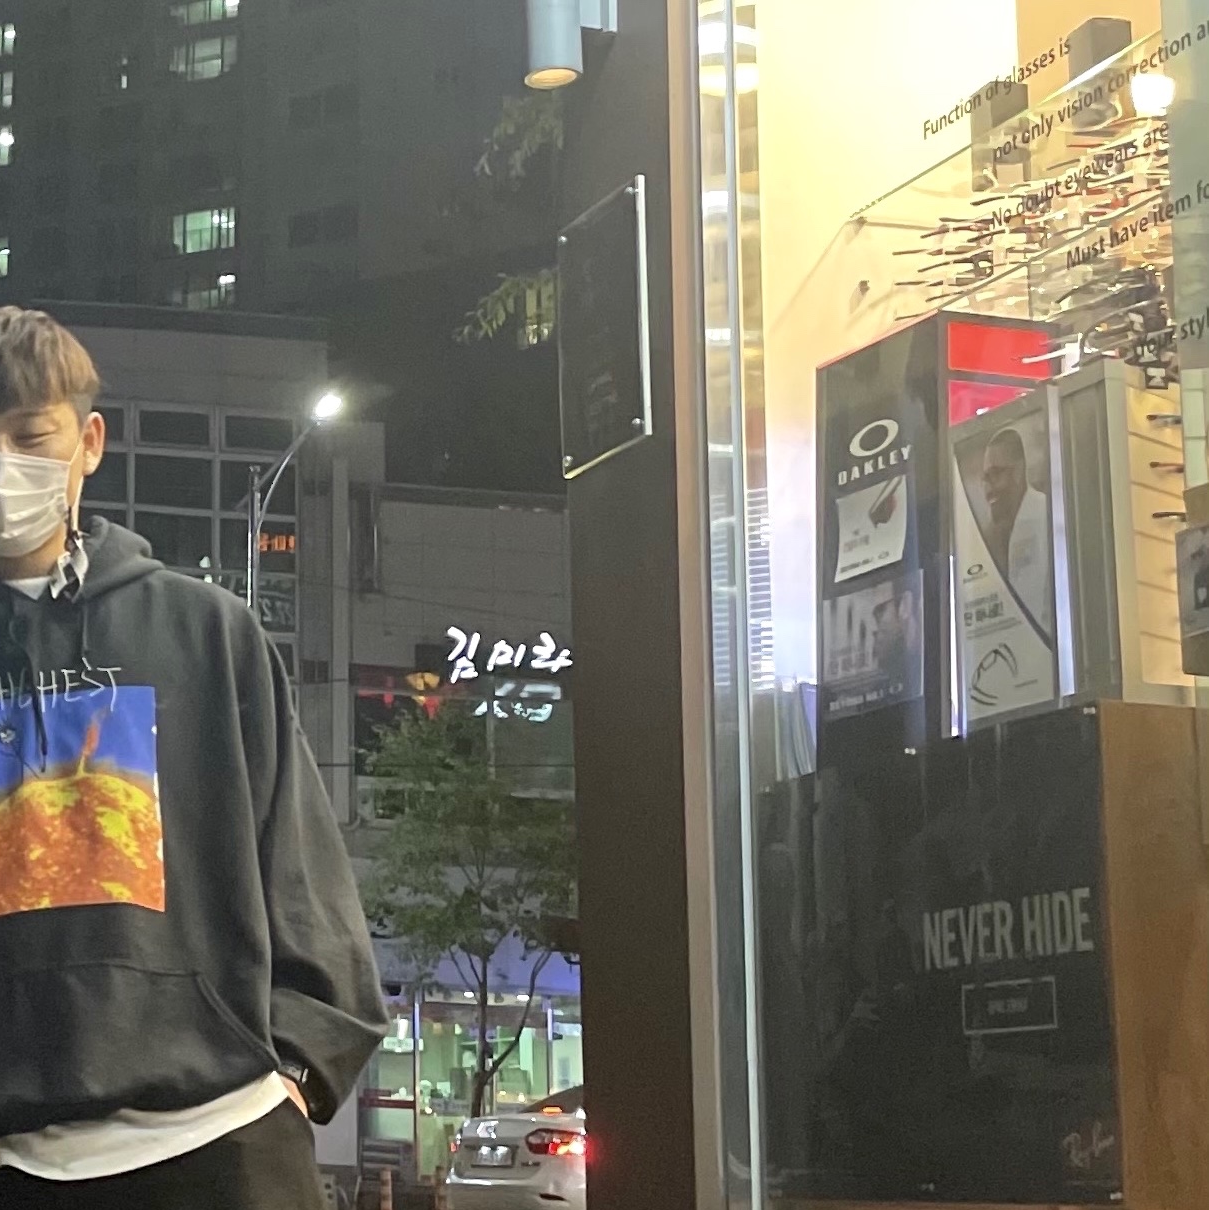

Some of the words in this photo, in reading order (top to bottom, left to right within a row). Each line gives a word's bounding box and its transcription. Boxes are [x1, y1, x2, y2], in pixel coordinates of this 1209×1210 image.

[923, 94, 981, 140] Function
[985, 75, 999, 101] of
[1003, 47, 1056, 95] glasses
[1058, 37, 1072, 57] is
[994, 134, 1017, 160] not
[1021, 113, 1053, 144] only
[1057, 86, 1103, 123] vision
[1107, 32, 1192, 94] correction
[992, 206, 1012, 229] No
[1016, 179, 1061, 213] doubt
[1143, 122, 1170, 148] are
[1067, 235, 1105, 269] Must
[1109, 216, 1149, 248] have
[1153, 193, 1191, 227] item
[838, 444, 912, 486] OAKLEY
[922, 901, 1014, 971] NEVER
[1022, 887, 1094, 960] HIDE
